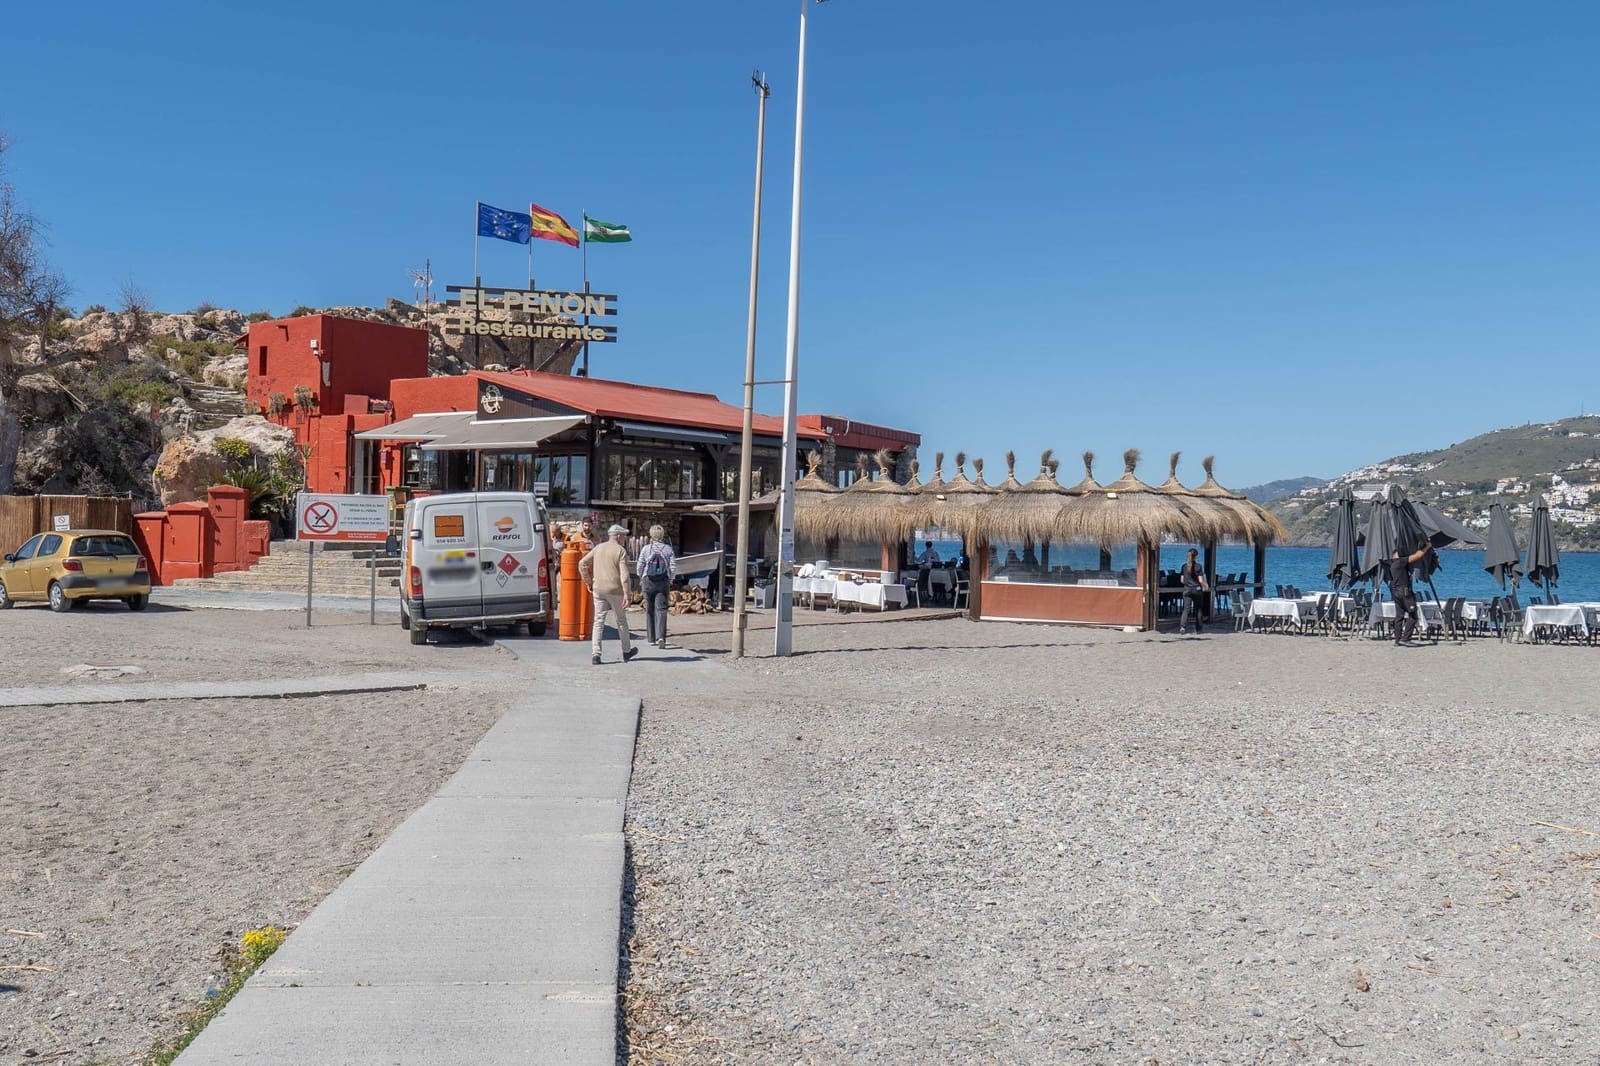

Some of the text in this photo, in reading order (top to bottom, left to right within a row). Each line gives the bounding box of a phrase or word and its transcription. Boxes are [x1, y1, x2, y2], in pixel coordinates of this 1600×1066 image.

[459, 288, 494, 311] EL
[459, 317, 606, 341] Restaurante
[492, 533, 521, 541] REPSOL
